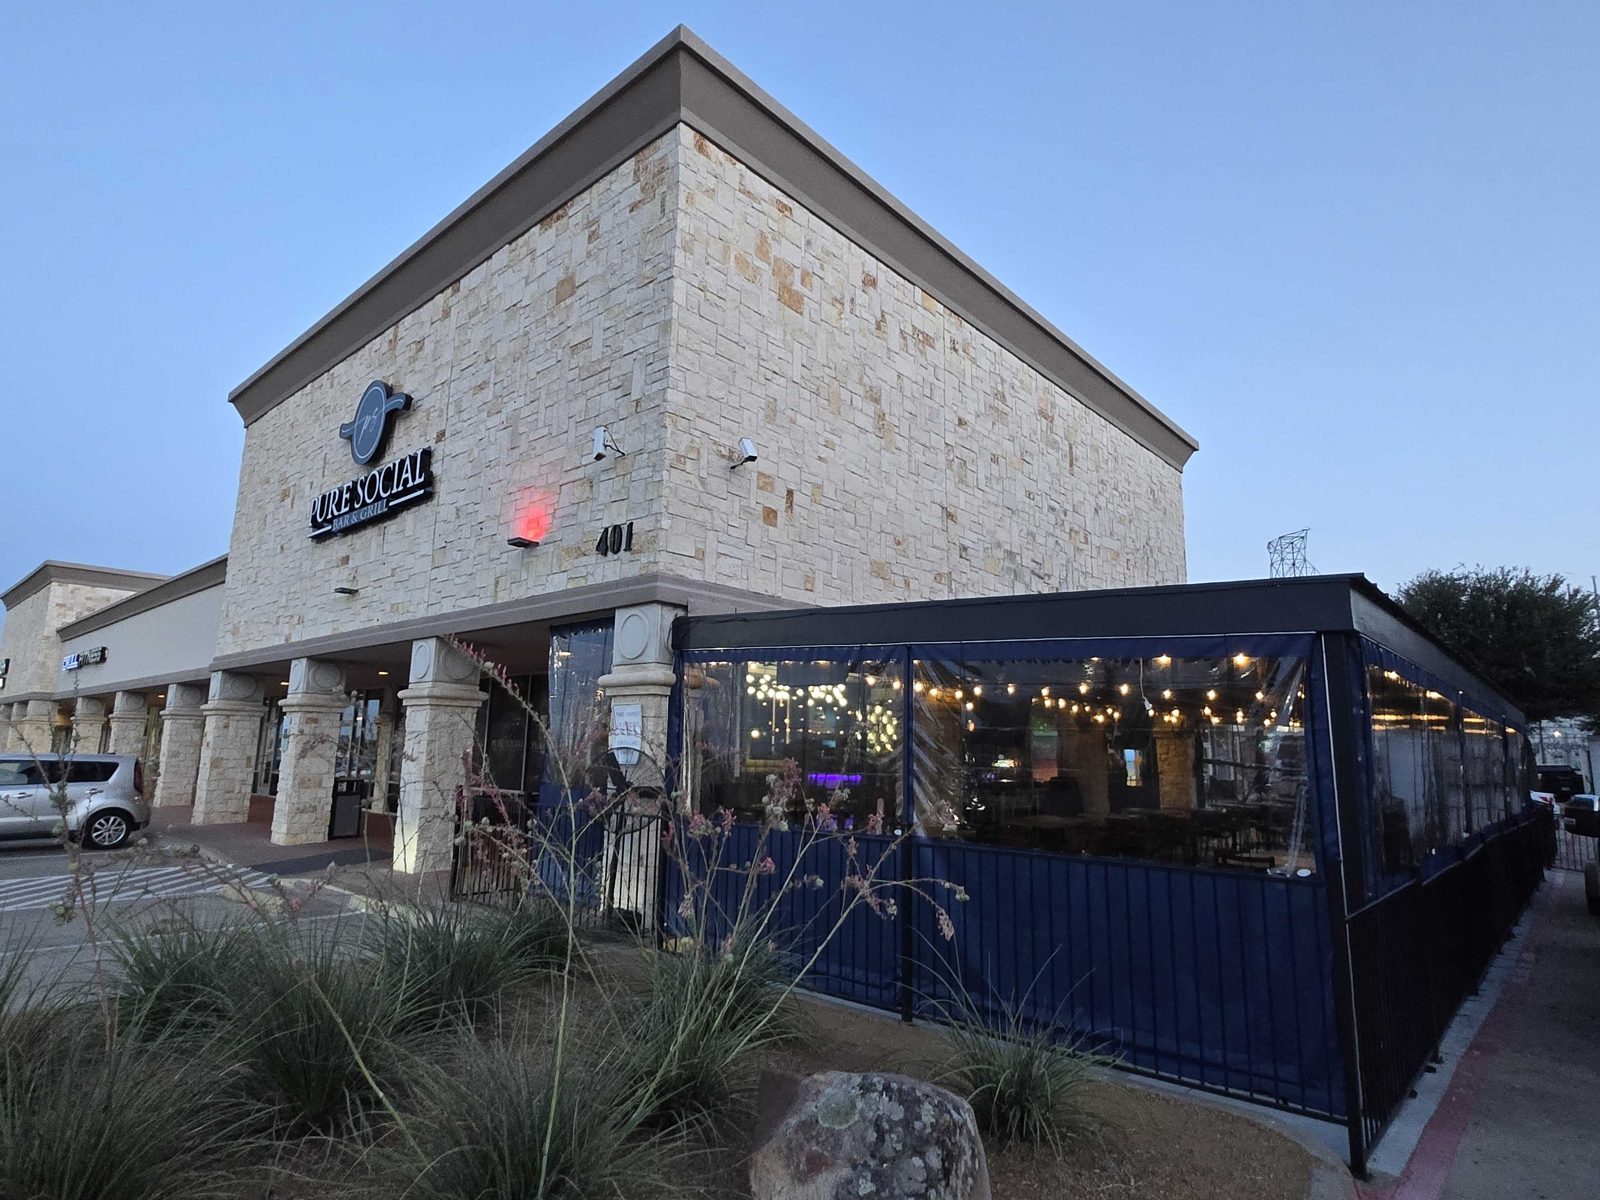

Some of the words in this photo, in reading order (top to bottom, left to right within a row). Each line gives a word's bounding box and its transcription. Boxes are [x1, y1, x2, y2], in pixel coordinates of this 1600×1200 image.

[308, 481, 352, 528] PURE
[354, 449, 425, 508] SOCIAL
[333, 515, 350, 530] BAR
[351, 513, 359, 523] &
[360, 499, 388, 520] GRILL
[595, 521, 634, 557] 401
